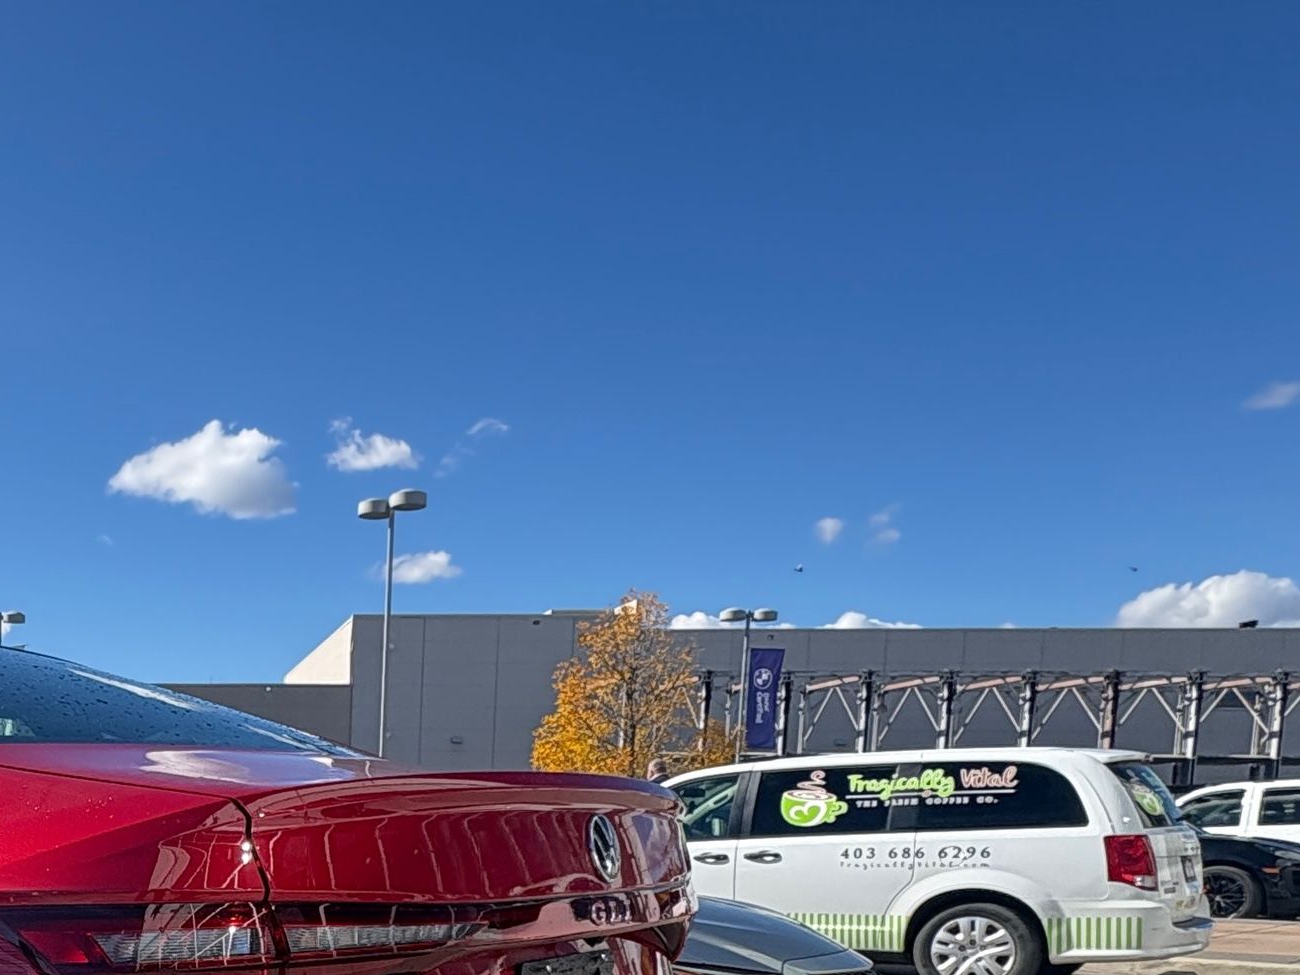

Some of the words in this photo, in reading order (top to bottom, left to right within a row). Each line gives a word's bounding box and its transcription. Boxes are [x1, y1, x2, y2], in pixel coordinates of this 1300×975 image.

[960, 765, 1020, 788] Vital
[840, 847, 876, 859] 403
[888, 847, 925, 859] 686
[938, 846, 991, 860] 6296
[591, 900, 632, 926] GLI
